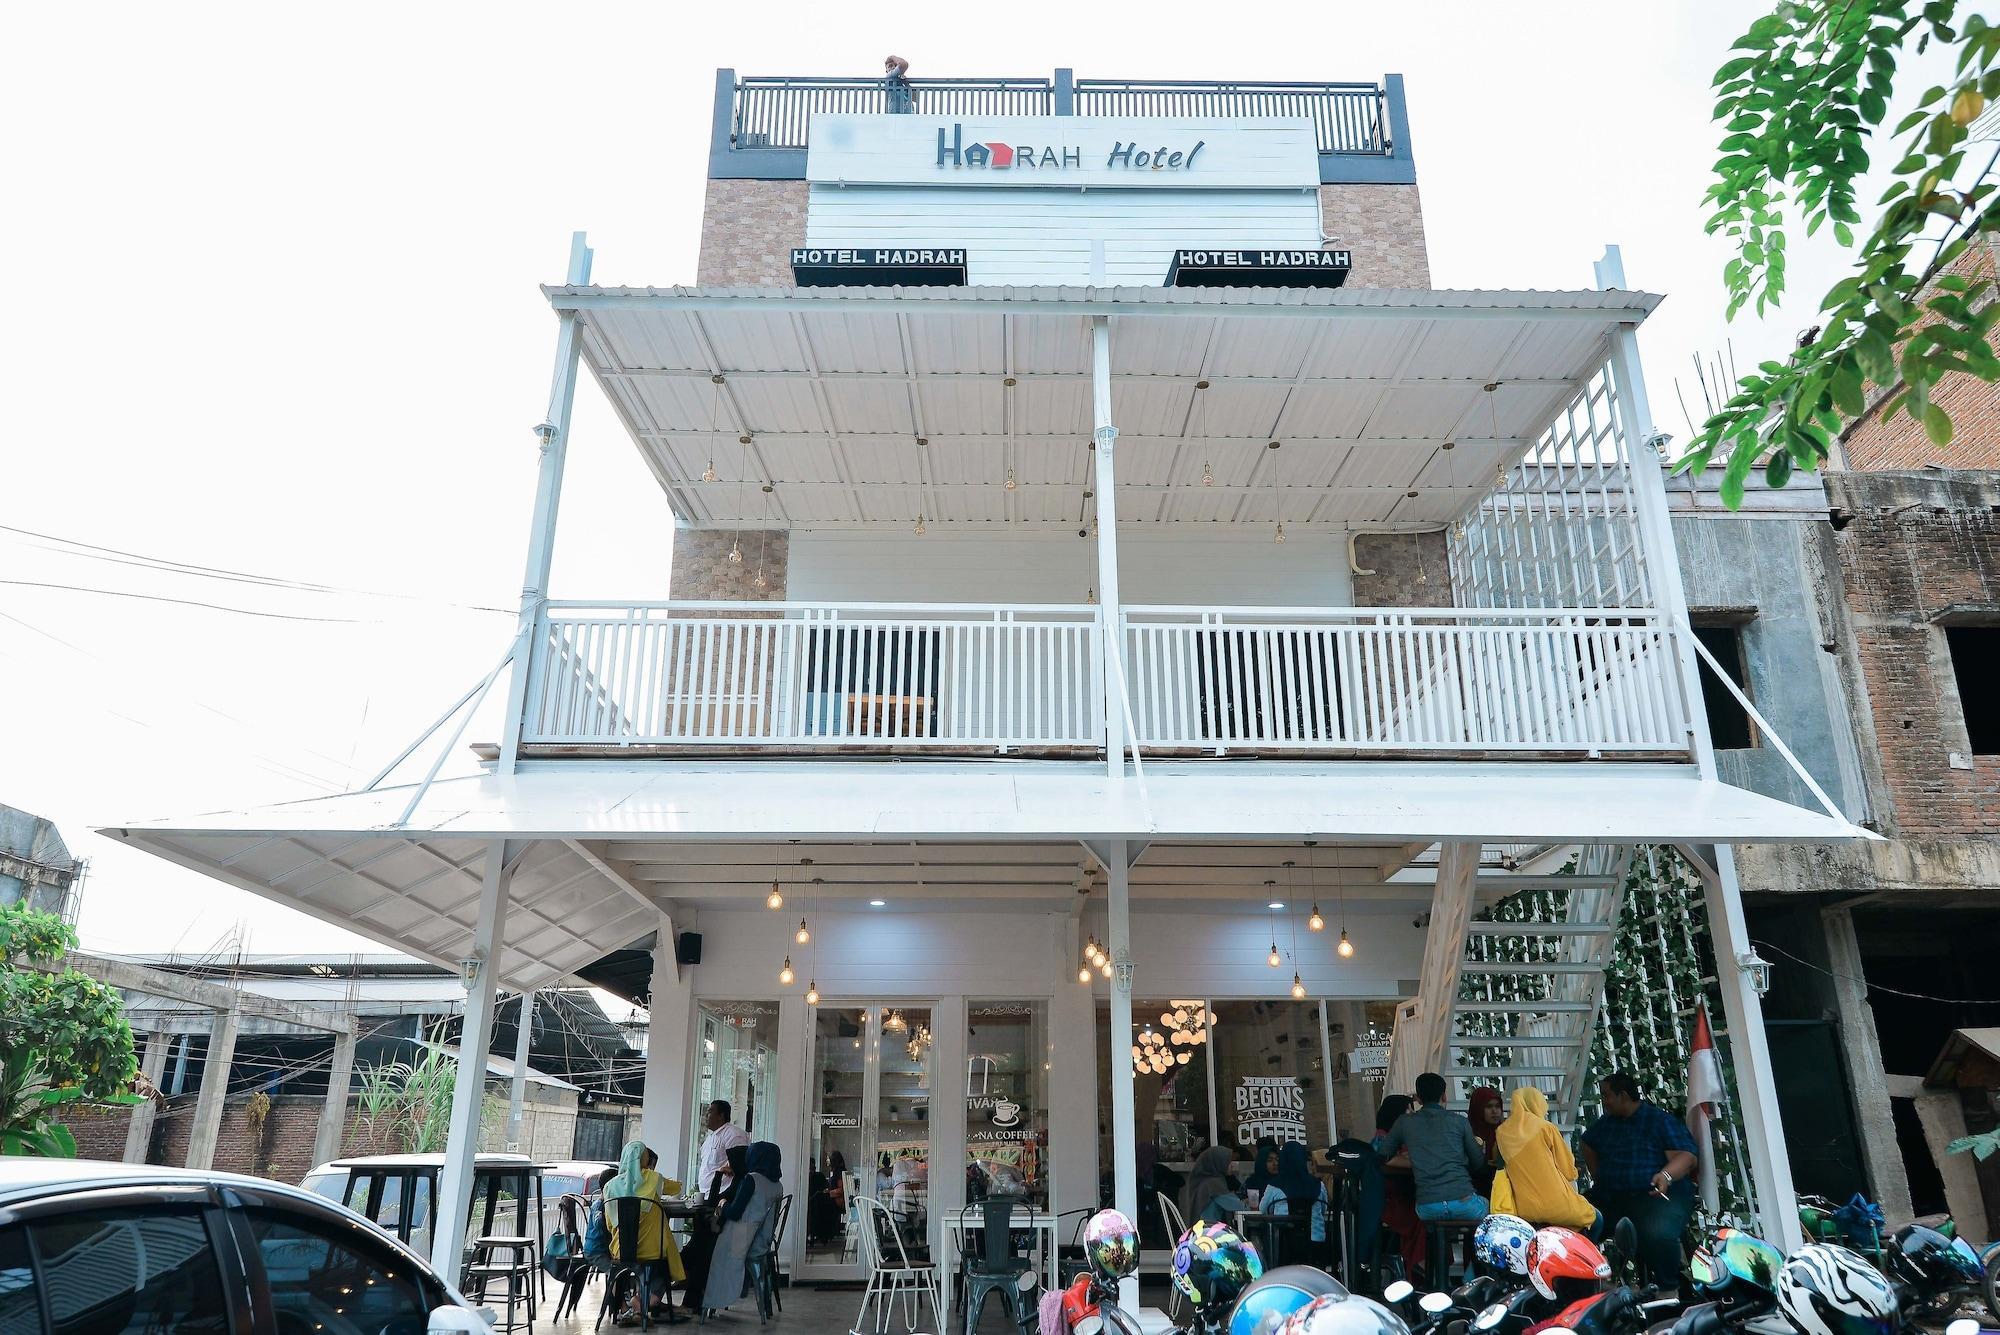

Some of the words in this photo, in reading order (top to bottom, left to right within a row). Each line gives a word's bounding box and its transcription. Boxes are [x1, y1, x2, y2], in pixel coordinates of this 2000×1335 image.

[1106, 140, 1205, 170] Hotel
[793, 250, 865, 264] HOTEL
[875, 250, 963, 264] HADRAH
[1179, 251, 1251, 265] HOTEL
[1261, 251, 1348, 265] HADRAH
[1357, 1032, 1376, 1041] YOU
[1236, 1086, 1305, 1111] BEGINS
[1245, 1110, 1298, 1120] AFTER
[995, 1131, 1034, 1139] COFFEE
[1238, 1121, 1307, 1145] COFFEE
